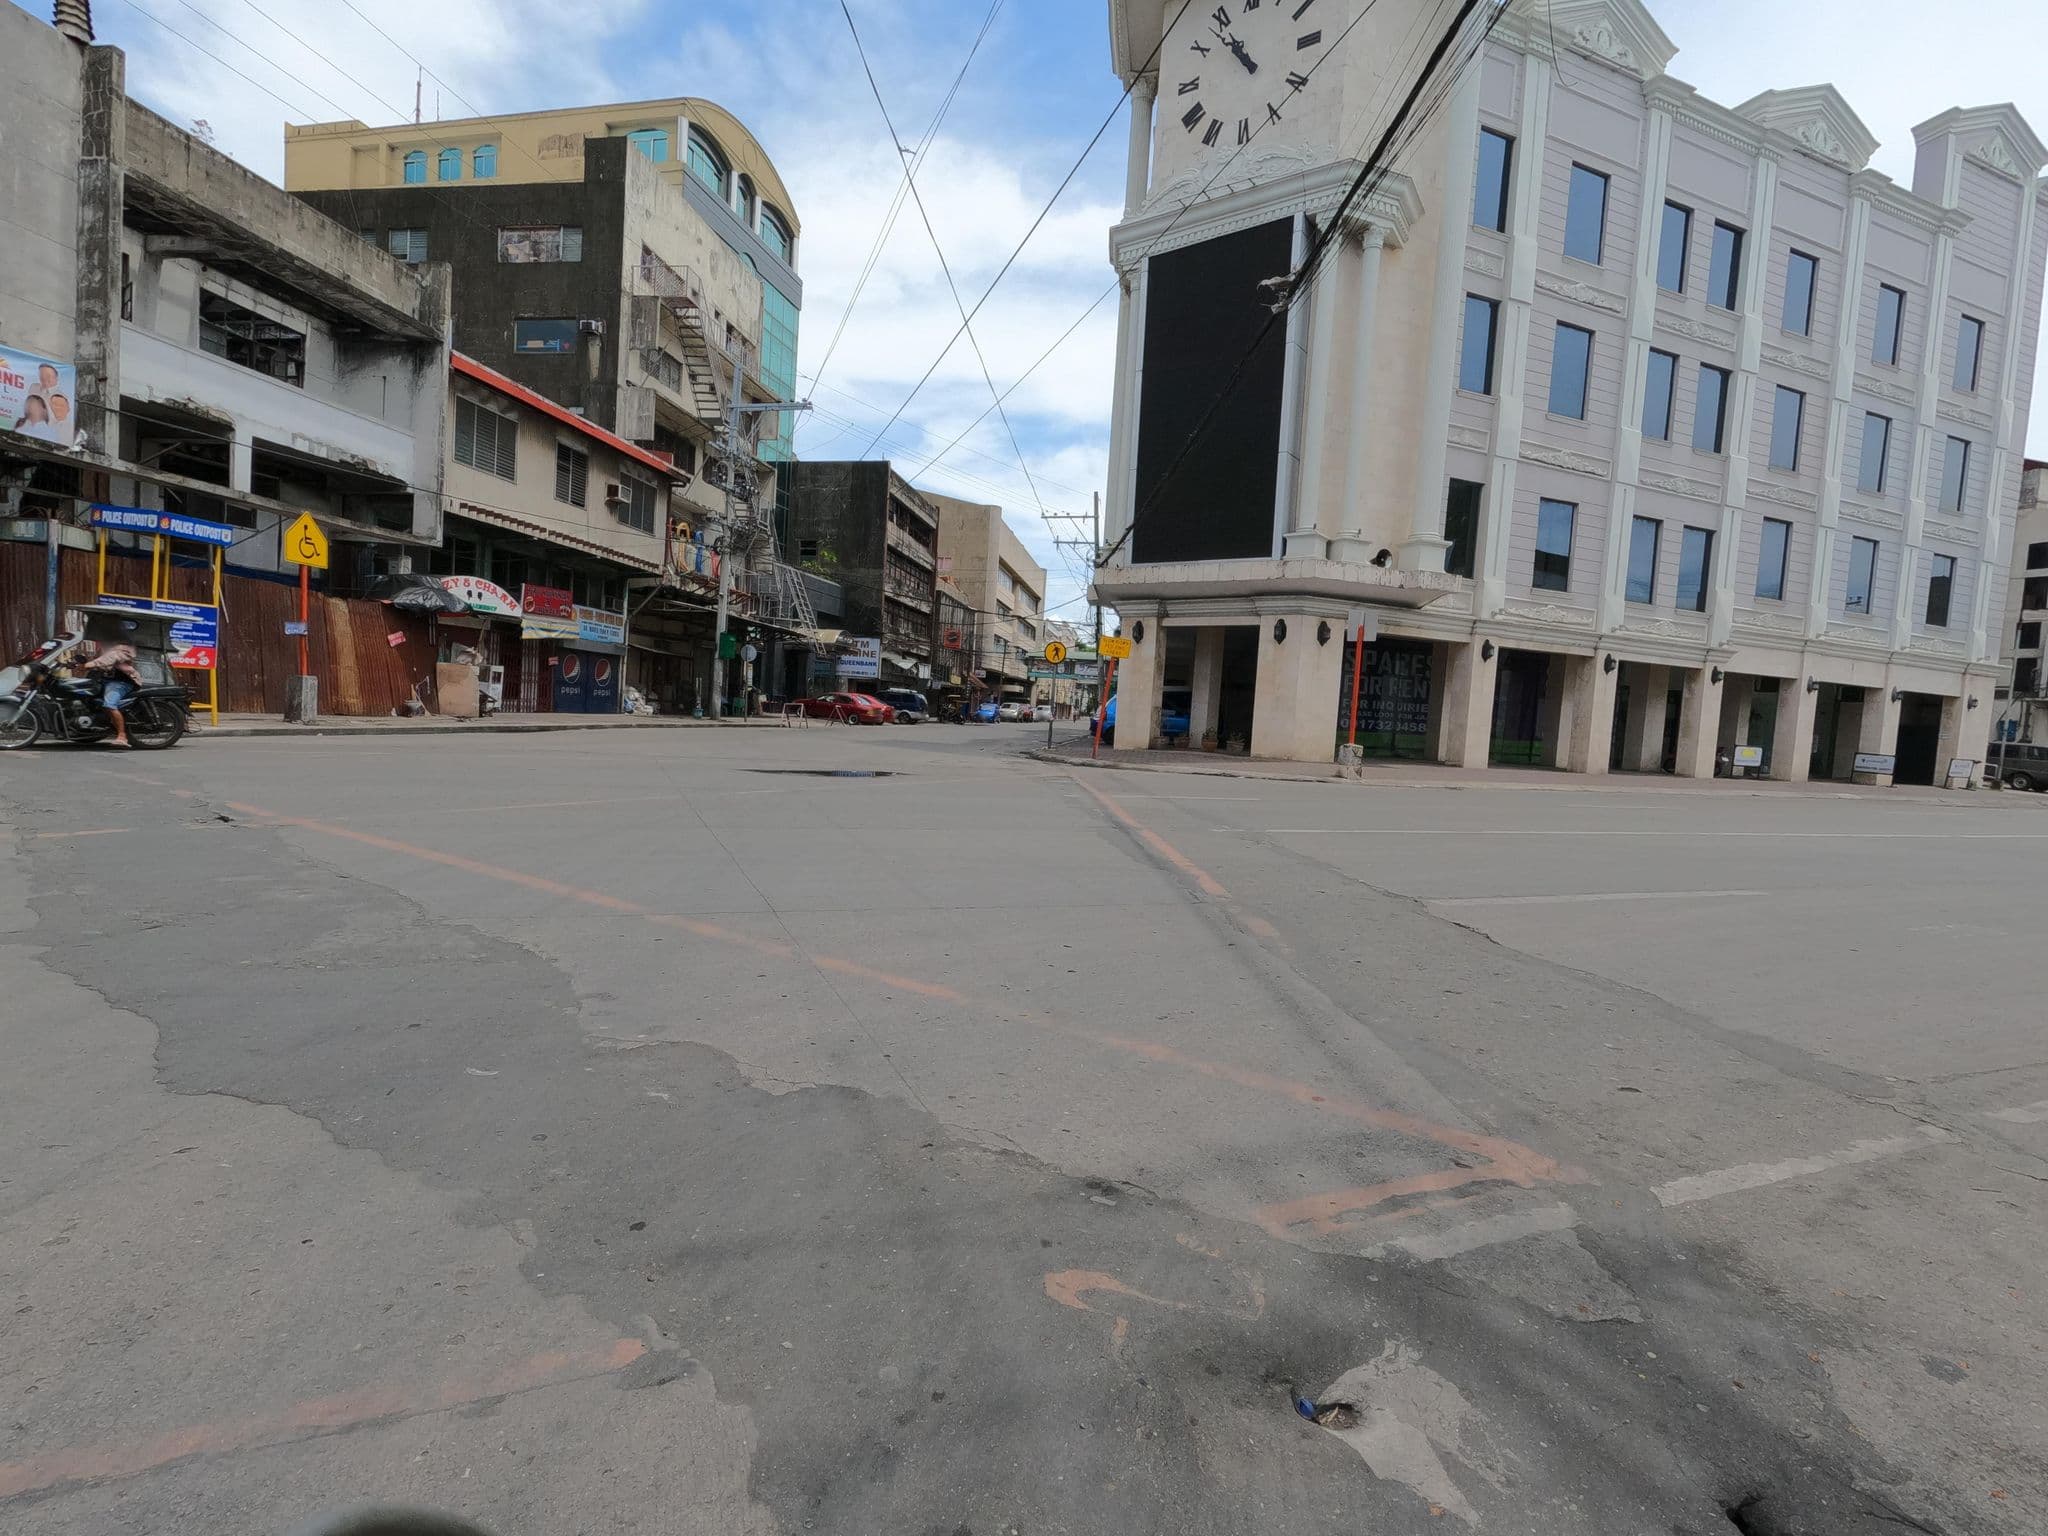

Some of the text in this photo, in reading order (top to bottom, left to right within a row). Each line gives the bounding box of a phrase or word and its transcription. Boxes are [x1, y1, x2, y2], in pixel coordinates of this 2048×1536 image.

[101, 510, 149, 527] POLICE OUTPOST
[170, 519, 221, 541] POLICE OUTPOST
[475, 580, 517, 612] CHARM
[561, 686, 580, 696] pepsi
[1388, 677, 1431, 699] REN
[1343, 699, 1430, 713] FR INQUIRIE
